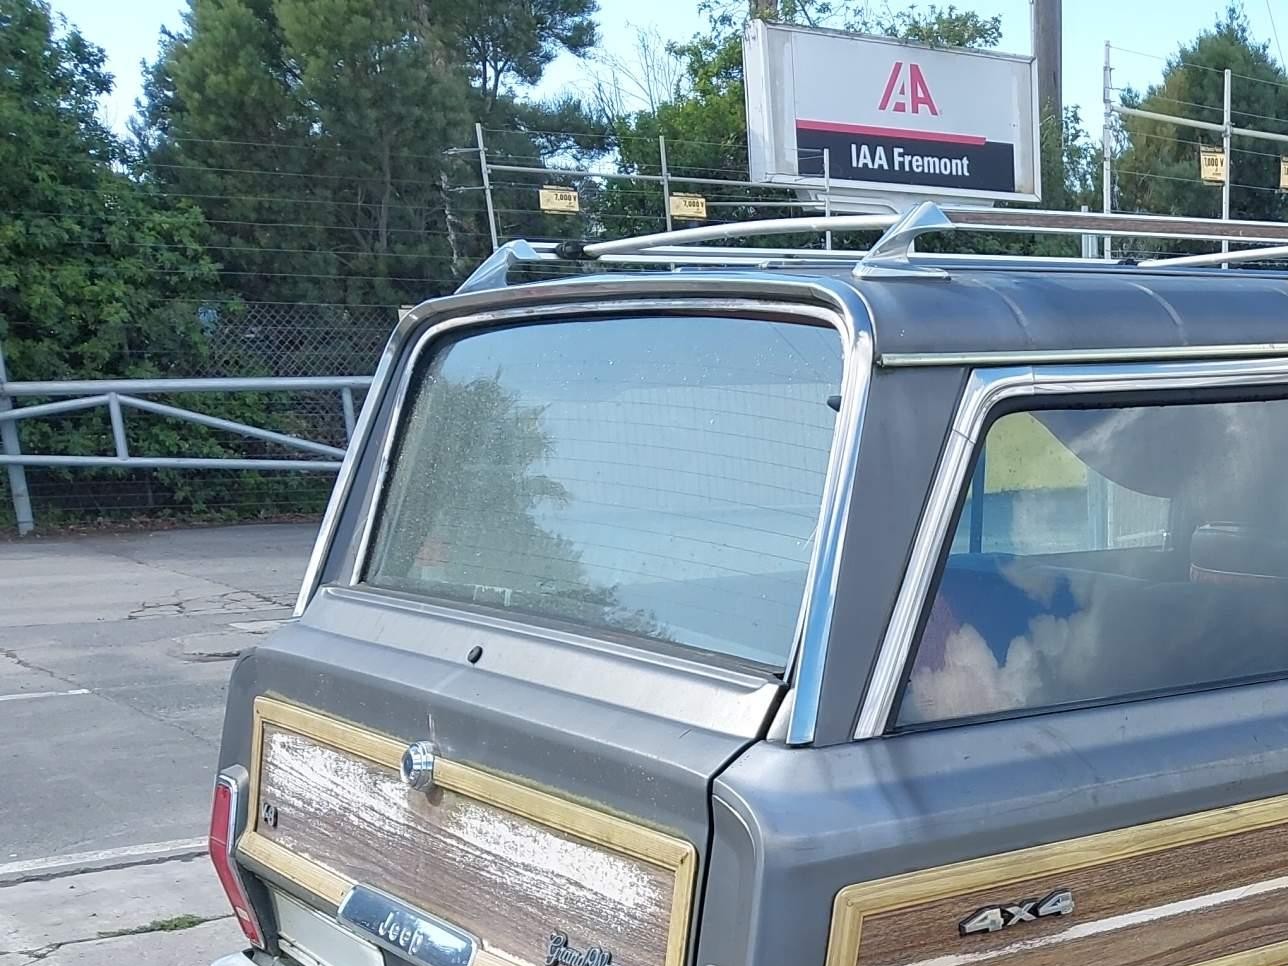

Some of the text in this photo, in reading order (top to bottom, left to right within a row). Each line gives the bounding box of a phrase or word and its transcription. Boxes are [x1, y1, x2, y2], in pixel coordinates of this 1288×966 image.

[851, 143, 969, 177] IAA Fremont
[378, 911, 425, 956] Jeep
